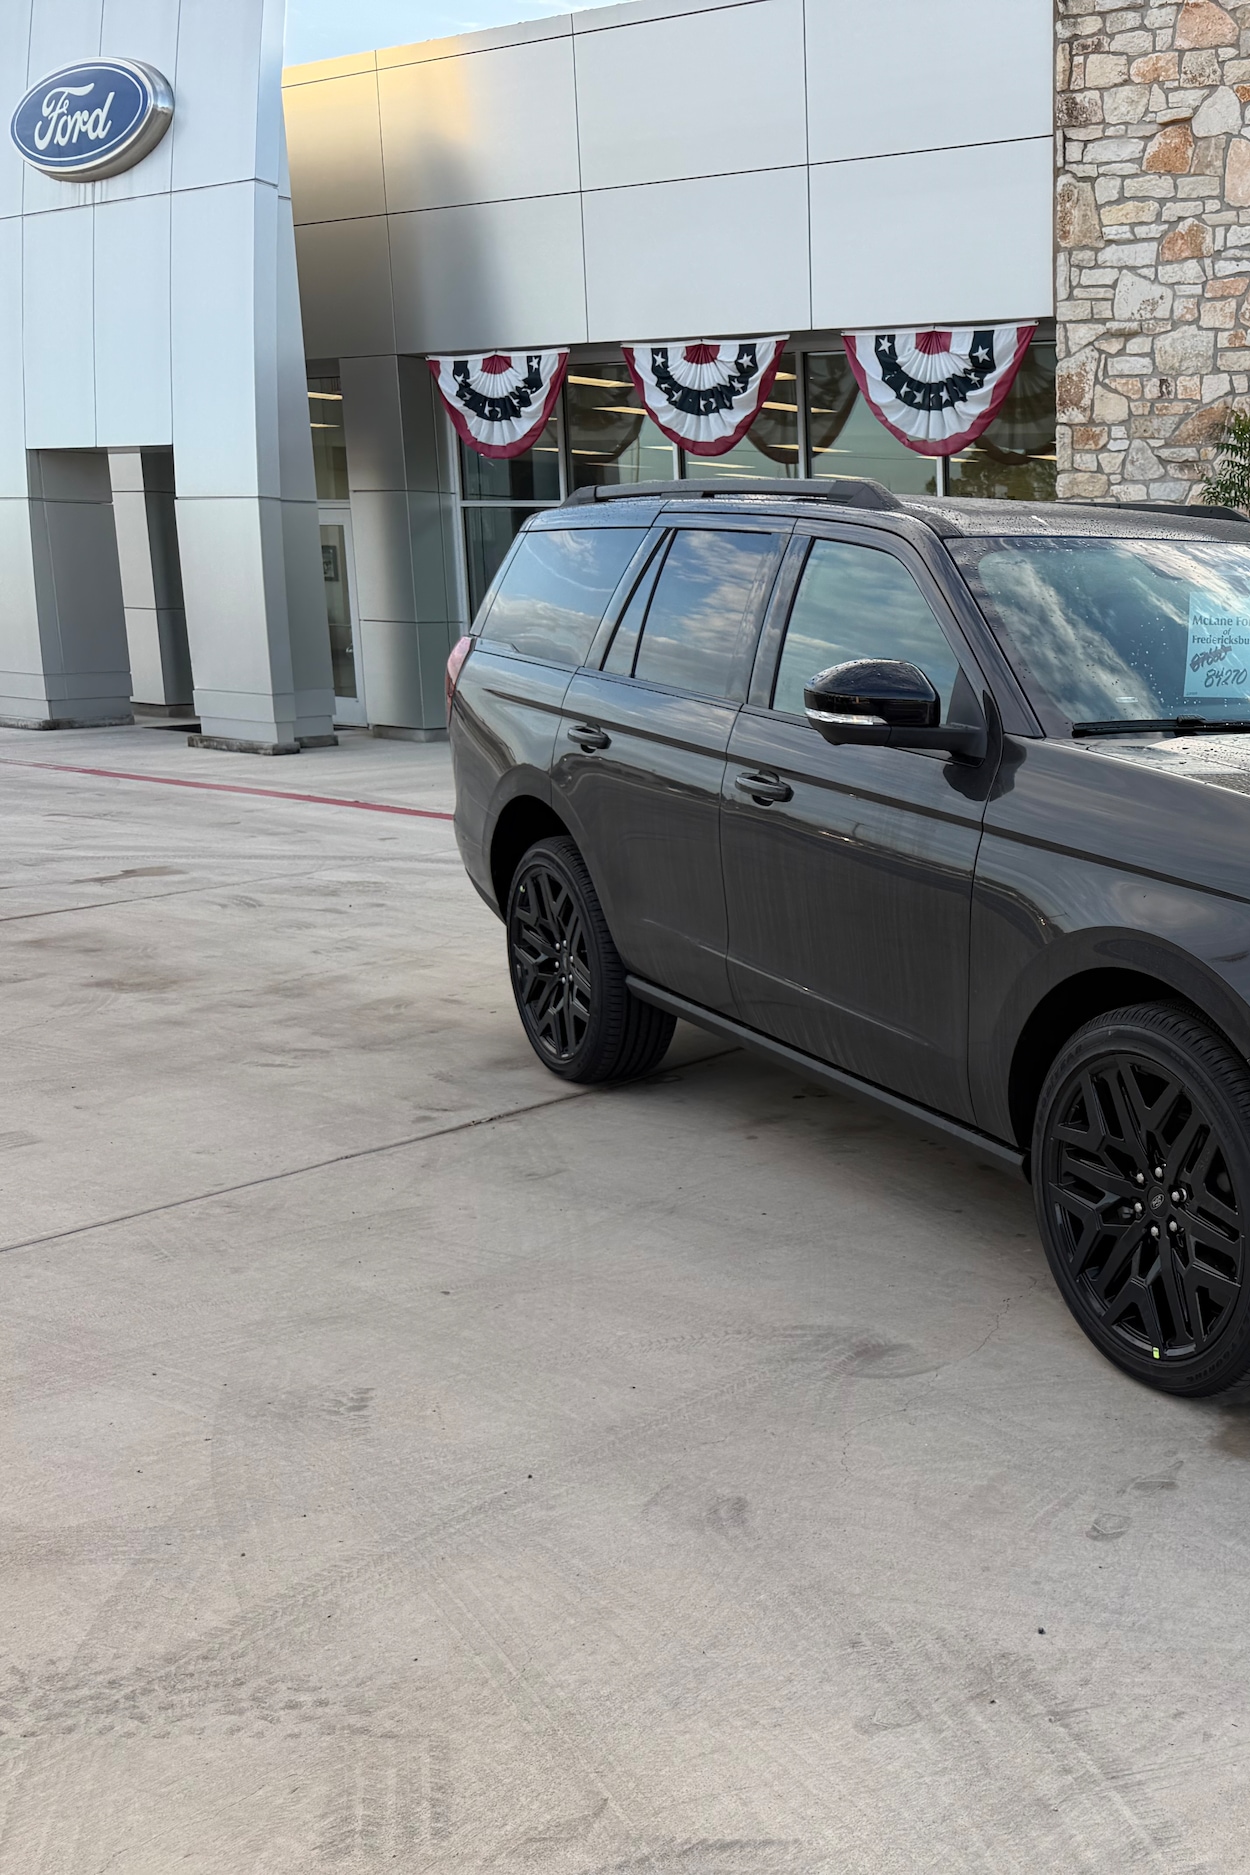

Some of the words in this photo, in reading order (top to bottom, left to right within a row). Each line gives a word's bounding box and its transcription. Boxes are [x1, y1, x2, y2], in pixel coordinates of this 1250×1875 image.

[34, 82, 116, 150] Ford
[1192, 615, 1233, 626] McLane
[1222, 628, 1231, 636] of
[1204, 667, 1248, 688] 84270
